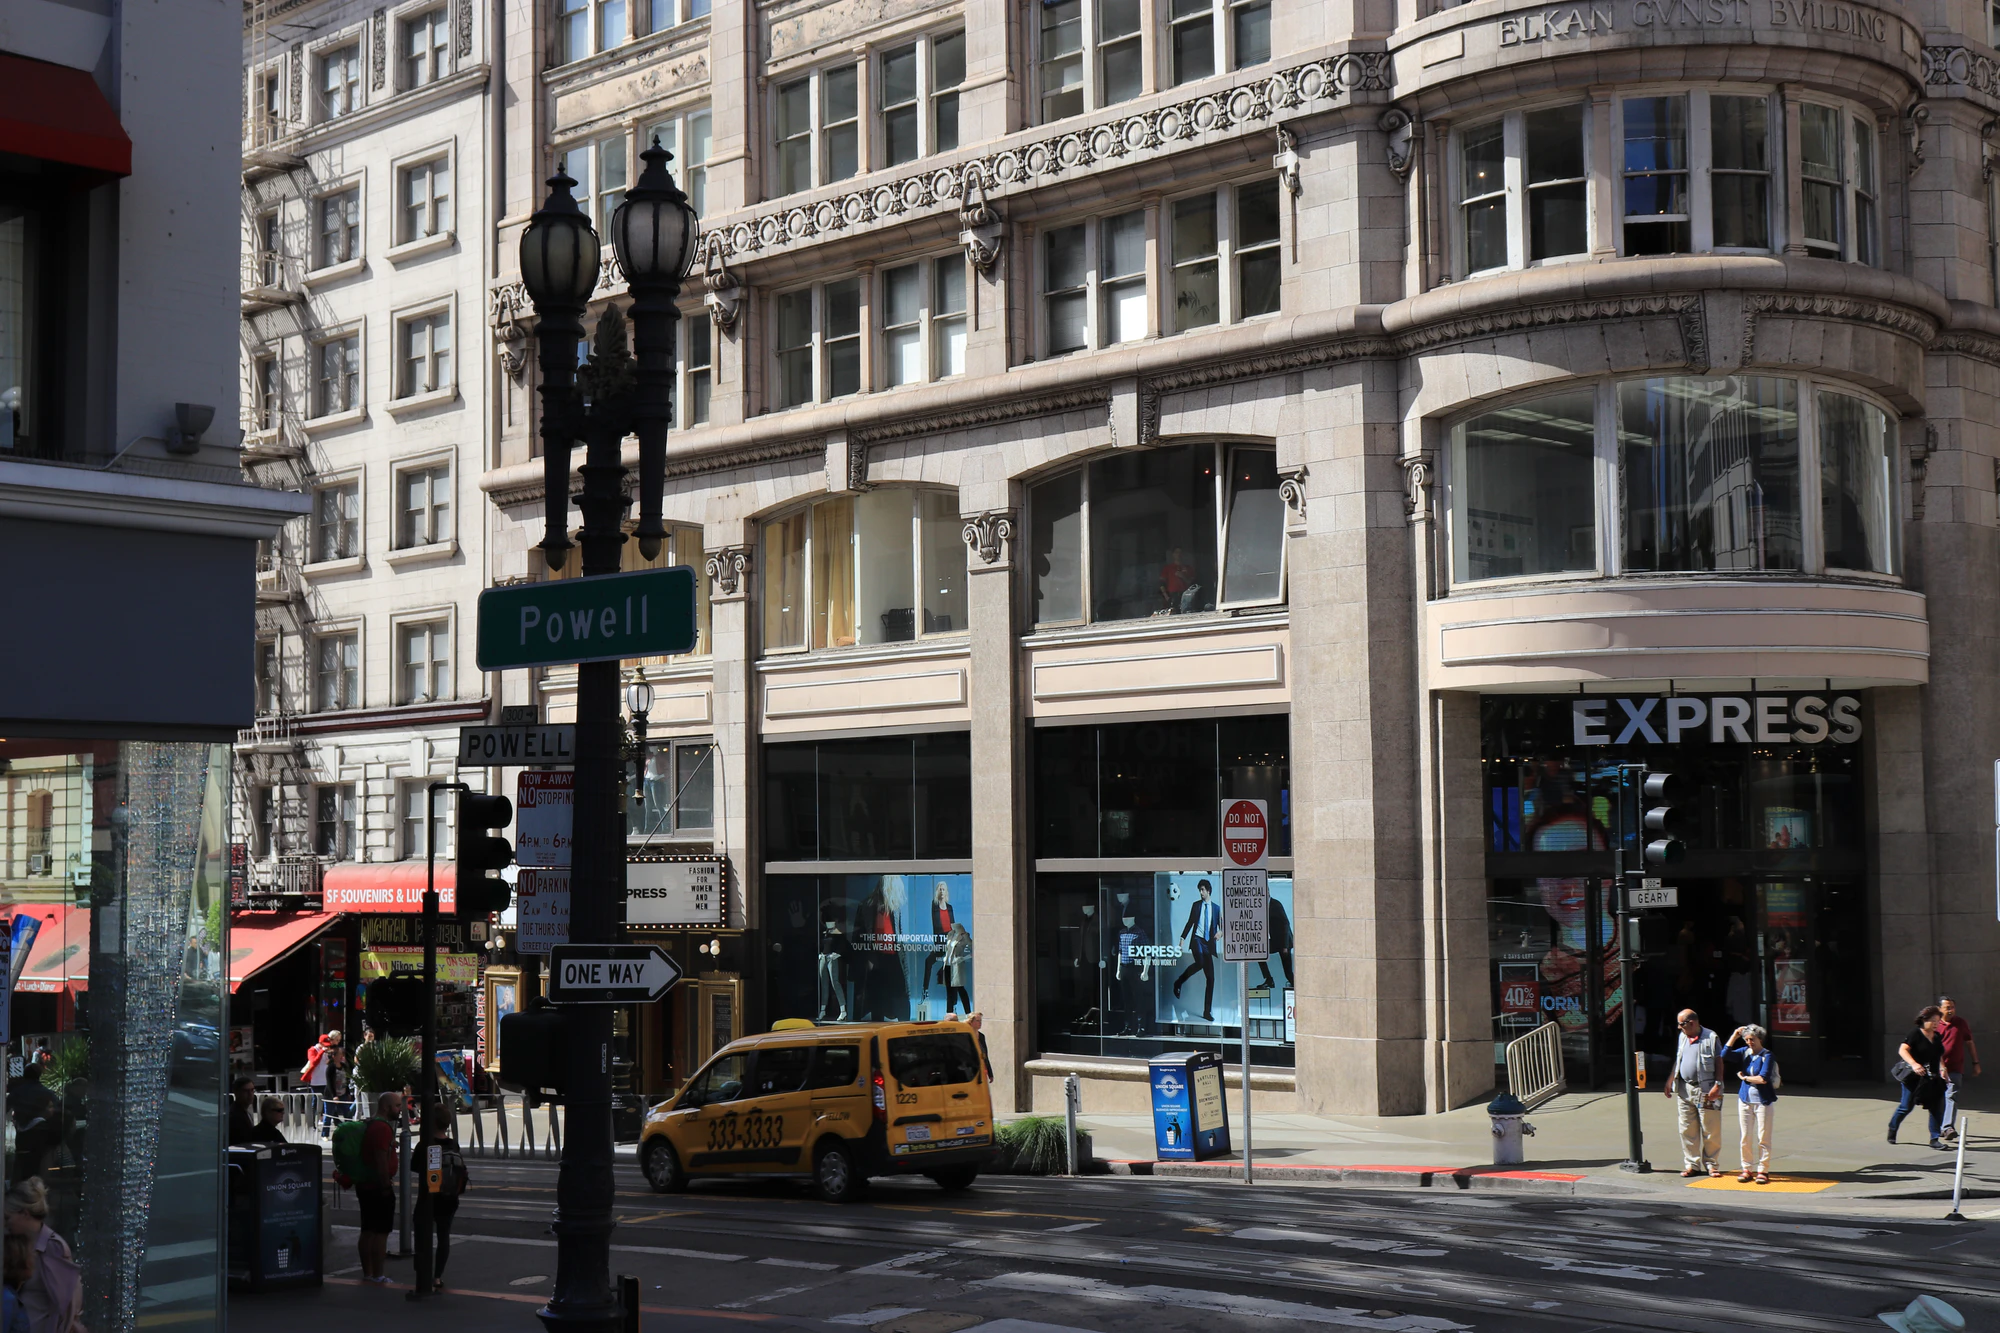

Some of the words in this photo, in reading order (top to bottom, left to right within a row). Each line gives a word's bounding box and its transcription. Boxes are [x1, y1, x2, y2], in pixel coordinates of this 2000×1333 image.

[1500, 8, 1613, 47] ELKAN
[1770, 0, 1887, 43] BVILDING
[520, 594, 648, 645] Powell
[505, 708, 523, 721] 300
[1573, 696, 1862, 745] EXPRESS
[467, 732, 570, 758] POWELL
[523, 774, 542, 785] TOW
[548, 774, 573, 785] AWAY
[519, 786, 536, 805] NO
[1229, 813, 1240, 824] DO
[1244, 813, 1261, 824] NOT
[1232, 842, 1258, 853] ENTER
[688, 867, 715, 875] FASHION
[520, 872, 535, 894] NO
[1232, 875, 1258, 886] EXCEPT
[627, 888, 667, 899] PRESS
[691, 884, 713, 893] WOMEN
[1225, 887, 1265, 897] COMMERCIAL
[326, 889, 339, 903] SF
[340, 888, 394, 903] SOUVENIRS
[396, 888, 404, 903] &
[406, 888, 454, 903] LUGGE
[695, 893, 708, 901] AND
[1637, 892, 1669, 904] GEARY
[523, 900, 530, 915] 2
[551, 900, 557, 915] 6
[695, 902, 708, 910] MEN
[1229, 898, 1262, 909] VEHICLES
[1239, 909, 1253, 920] AND
[522, 922, 534, 936] TUE
[535, 922, 555, 936] THURS
[1229, 921, 1263, 931] VEHICLES
[361, 917, 408, 950] DIGITAL
[877, 933, 897, 942] MOST
[897, 934, 938, 942] IMPORTANT
[1231, 932, 1261, 943] LOADING
[522, 941, 541, 950] STREET
[872, 943, 893, 951] WEAR
[893, 944, 901, 952] IS
[902, 944, 922, 952] YOUR
[1226, 943, 1237, 954] ON
[1239, 943, 1266, 954] POWELL
[1128, 945, 1182, 958] EXPRESS
[446, 956, 457, 967] ON
[459, 956, 476, 967] SALE
[565, 963, 602, 985] ONE
[608, 963, 645, 984] WAY
[895, 1093, 918, 1104] 1229
[707, 1115, 783, 1150] 333-3333
[267, 1183, 287, 1191] UNION
[288, 1181, 312, 1190] SQUARE
